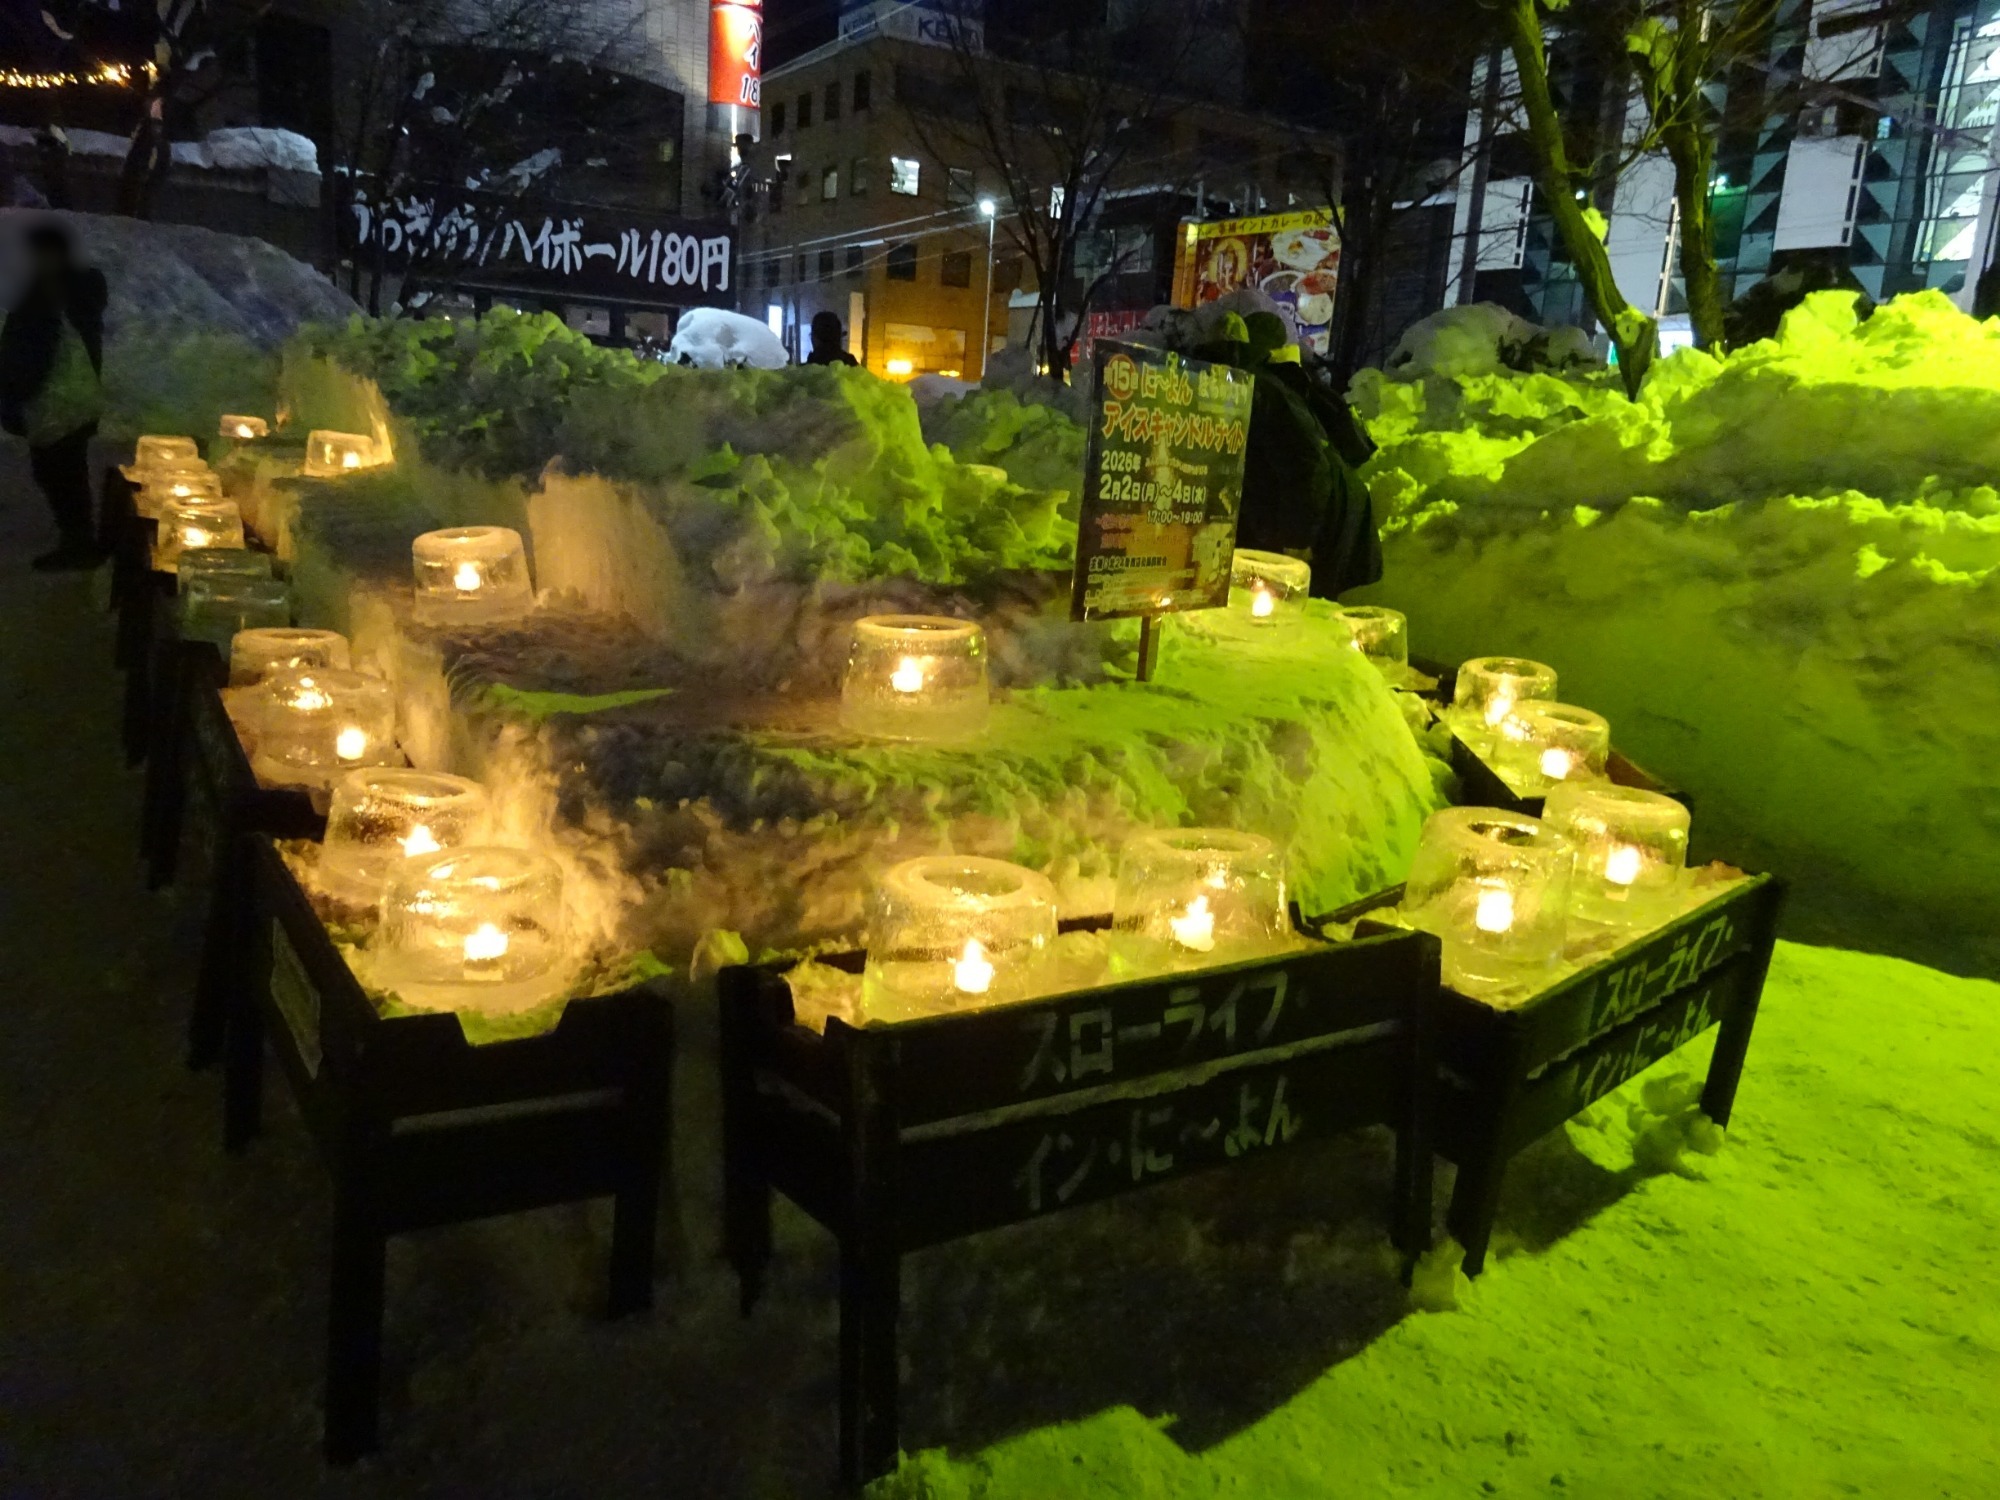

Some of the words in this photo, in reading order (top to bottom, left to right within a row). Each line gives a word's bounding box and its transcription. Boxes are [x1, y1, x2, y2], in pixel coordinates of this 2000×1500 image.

[1101, 400, 1245, 455] アイスキャンドルナイト
[1101, 449, 1142, 474] 2026年
